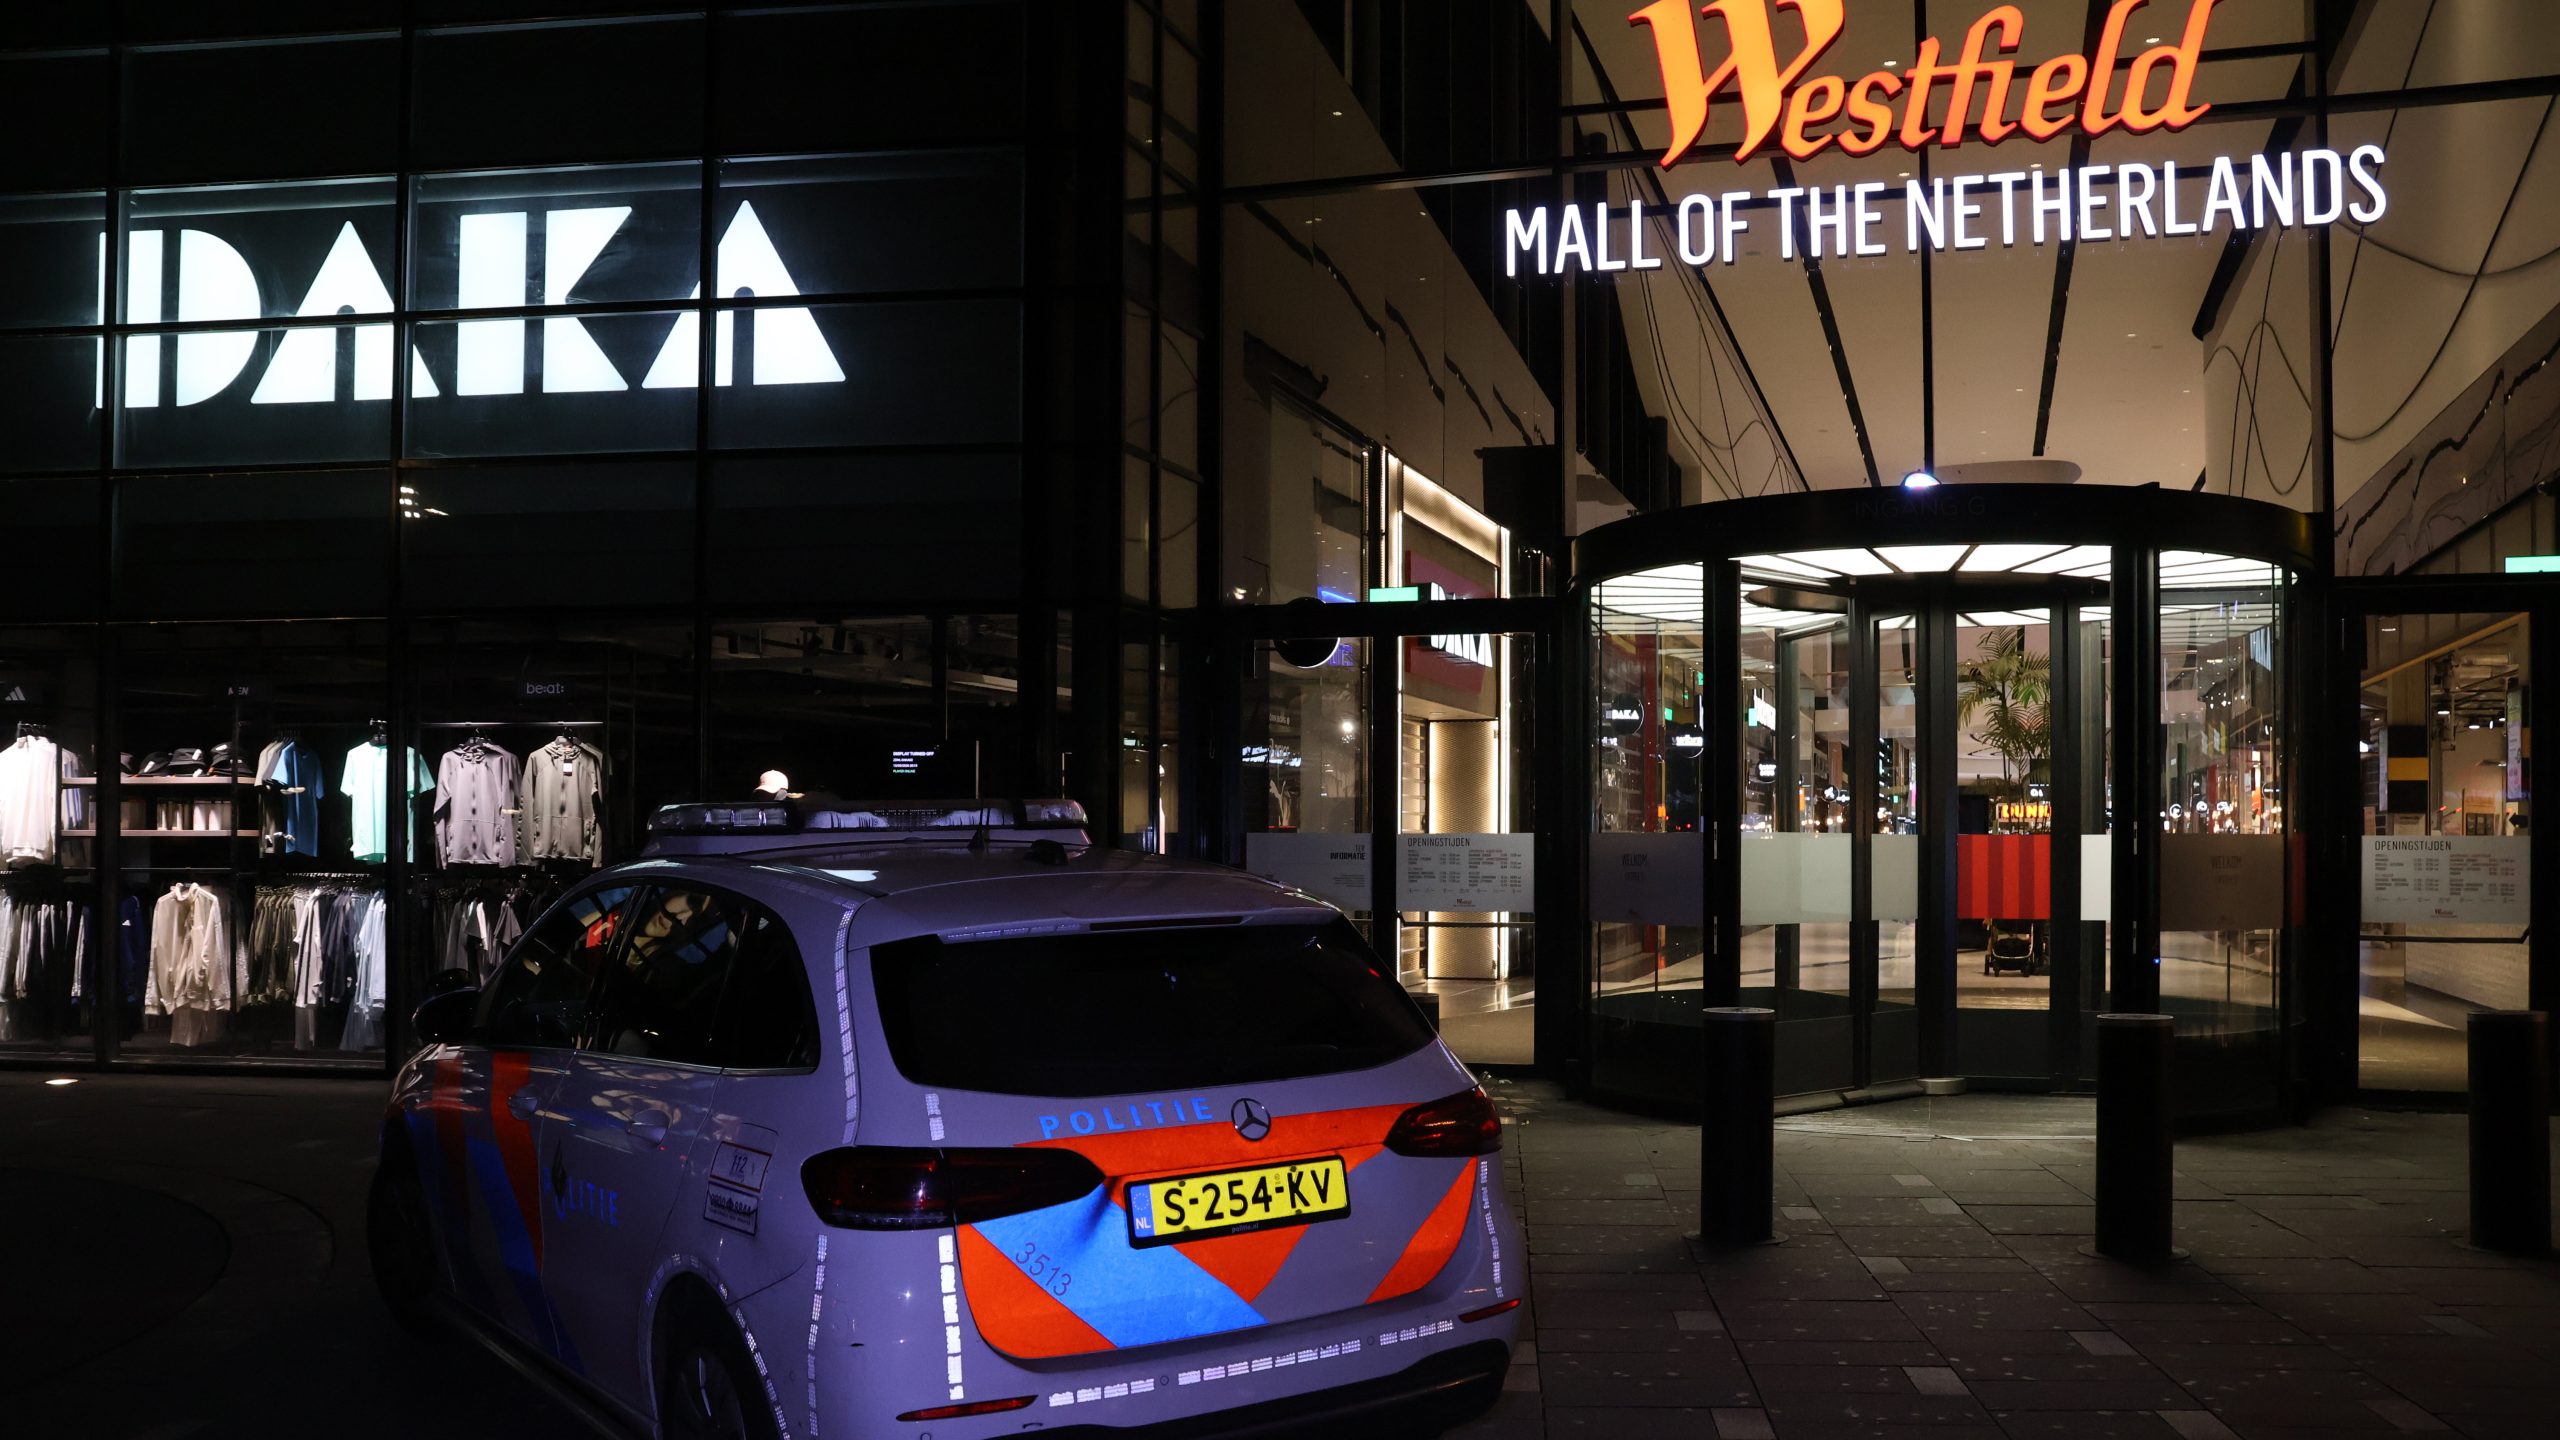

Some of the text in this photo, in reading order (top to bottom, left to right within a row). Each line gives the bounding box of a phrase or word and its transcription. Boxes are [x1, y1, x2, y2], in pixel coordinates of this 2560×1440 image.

[1627, 0, 2216, 168] Westfield
[1505, 144, 2387, 278] MALL OF THE NETHERLANDS
[95, 199, 847, 410] DAKA
[1329, 852, 1366, 861] INFORMATIE
[1407, 837, 1471, 847] OPENINGSTIJDEN
[2374, 840, 2452, 851] OPENINGSTIJDEN
[1038, 1096, 1214, 1139] POLITIE
[730, 1154, 749, 1174] 112
[1163, 1167, 1331, 1226] S-254-KV
[1135, 1216, 1152, 1230] NL
[1230, 1222, 1260, 1234] politie.nl
[1014, 1241, 1073, 1297] 3513
